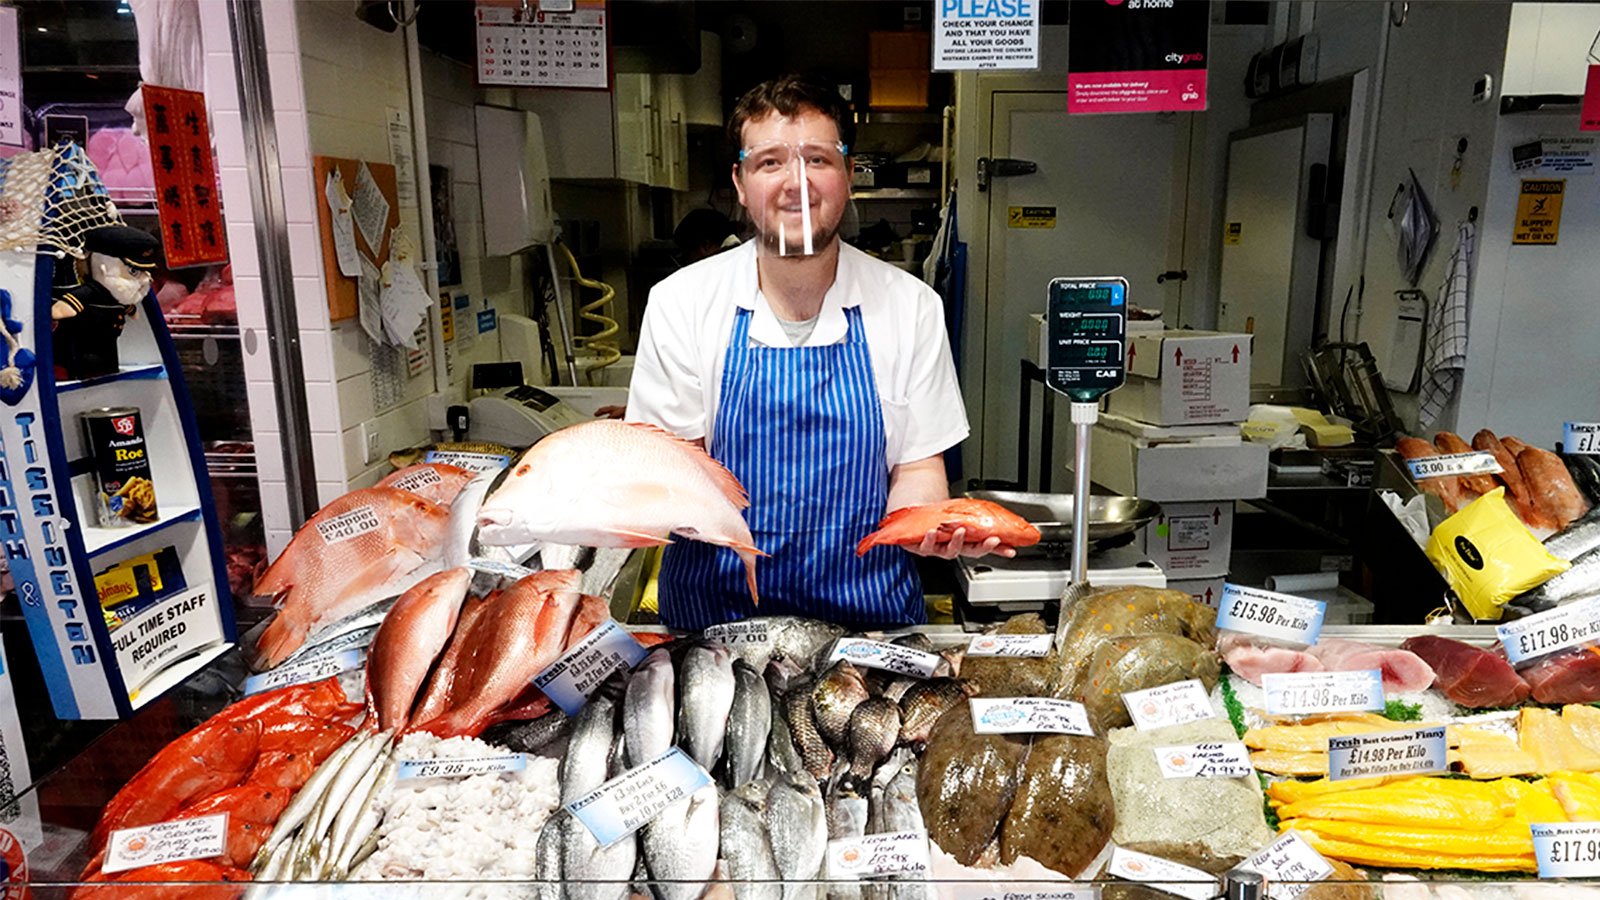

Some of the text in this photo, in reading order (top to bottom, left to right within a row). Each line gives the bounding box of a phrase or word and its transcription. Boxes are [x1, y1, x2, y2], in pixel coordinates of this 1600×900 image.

[942, 0, 1031, 18] PLEASE
[1165, 52, 1203, 64] citygrab
[1182, 92, 1199, 101] grab
[1523, 183, 1561, 192] CAUTION
[1571, 424, 1595, 432] Large
[109, 436, 143, 447] Amanda
[115, 449, 144, 461] Roe
[1415, 463, 1443, 474] £3.00
[397, 470, 435, 488] napper
[320, 511, 373, 534] Snapper
[325, 518, 379, 540] £40.00
[22, 582, 40, 607] &
[98, 582, 133, 601] olman's
[112, 594, 206, 652] FULL TIME STAFF
[1229, 600, 1308, 630] £15.98 Per Kilo
[706, 622, 767, 638] Fresh Stone Bass
[132, 622, 186, 664] REQUIRED
[1520, 624, 1587, 655] £17.98 Per
[534, 662, 566, 686] Fresh
[564, 645, 588, 664] Whole
[586, 650, 602, 666] Each
[585, 672, 592, 684] 2
[1332, 694, 1348, 706] Per
[1350, 693, 1368, 705] Kilo
[1329, 738, 1360, 748] Fresh
[1415, 730, 1446, 739] Finny
[1349, 744, 1426, 764] £14.98 Per Kilo
[416, 764, 463, 776] £9.98
[570, 790, 602, 811] Fresh
[651, 750, 679, 766] Bream
[619, 803, 634, 816] Buy
[634, 796, 641, 806] 2
[654, 782, 667, 795] £6
[624, 816, 639, 829] Buy
[640, 807, 651, 818] 10
[665, 786, 684, 803] £28
[1252, 833, 1295, 867] FRESH LEMON
[1272, 853, 1290, 870] SOLE
